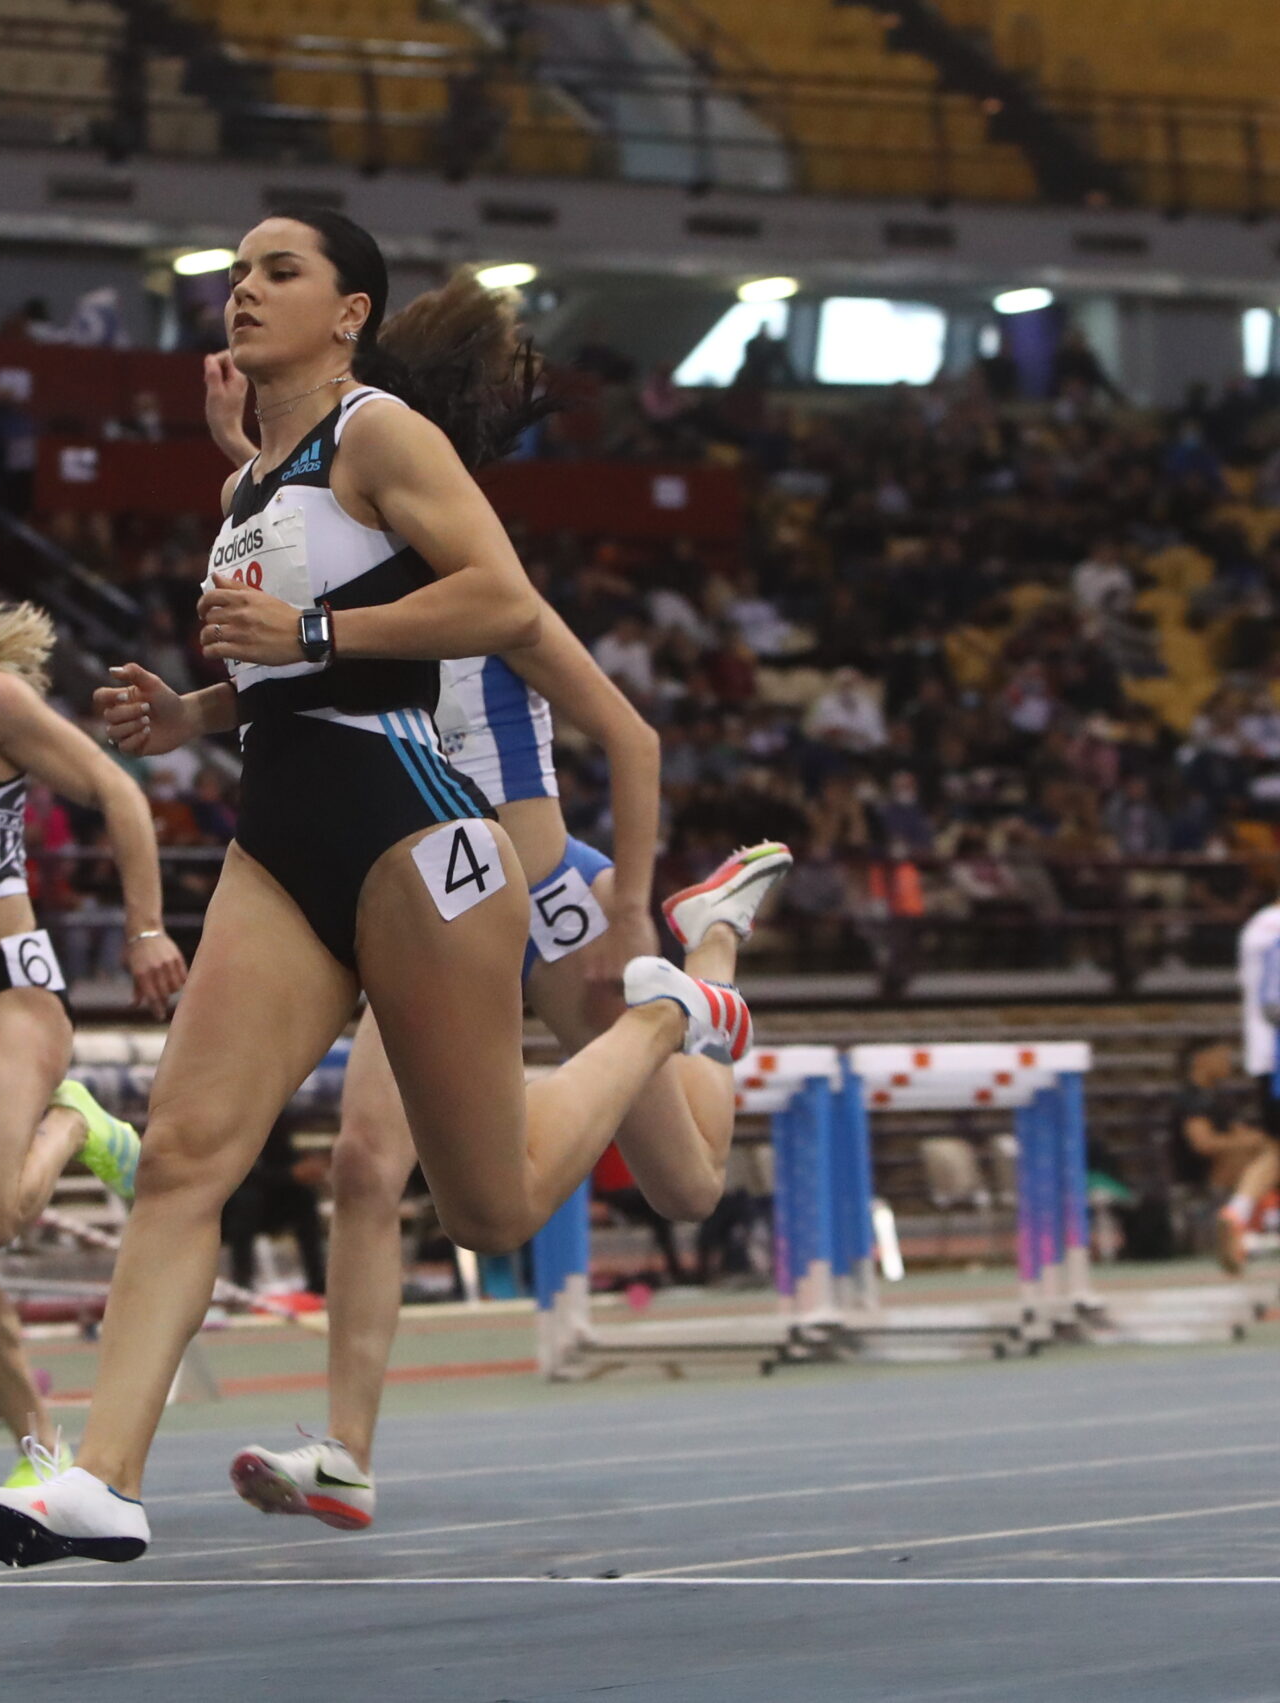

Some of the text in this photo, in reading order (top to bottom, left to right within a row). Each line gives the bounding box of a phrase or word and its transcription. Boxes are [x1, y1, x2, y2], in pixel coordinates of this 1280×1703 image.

[281, 458, 322, 482] adidas
[213, 527, 264, 568] adidas
[444, 825, 490, 894] 4
[535, 883, 589, 947] 5
[18, 937, 52, 988] 6
